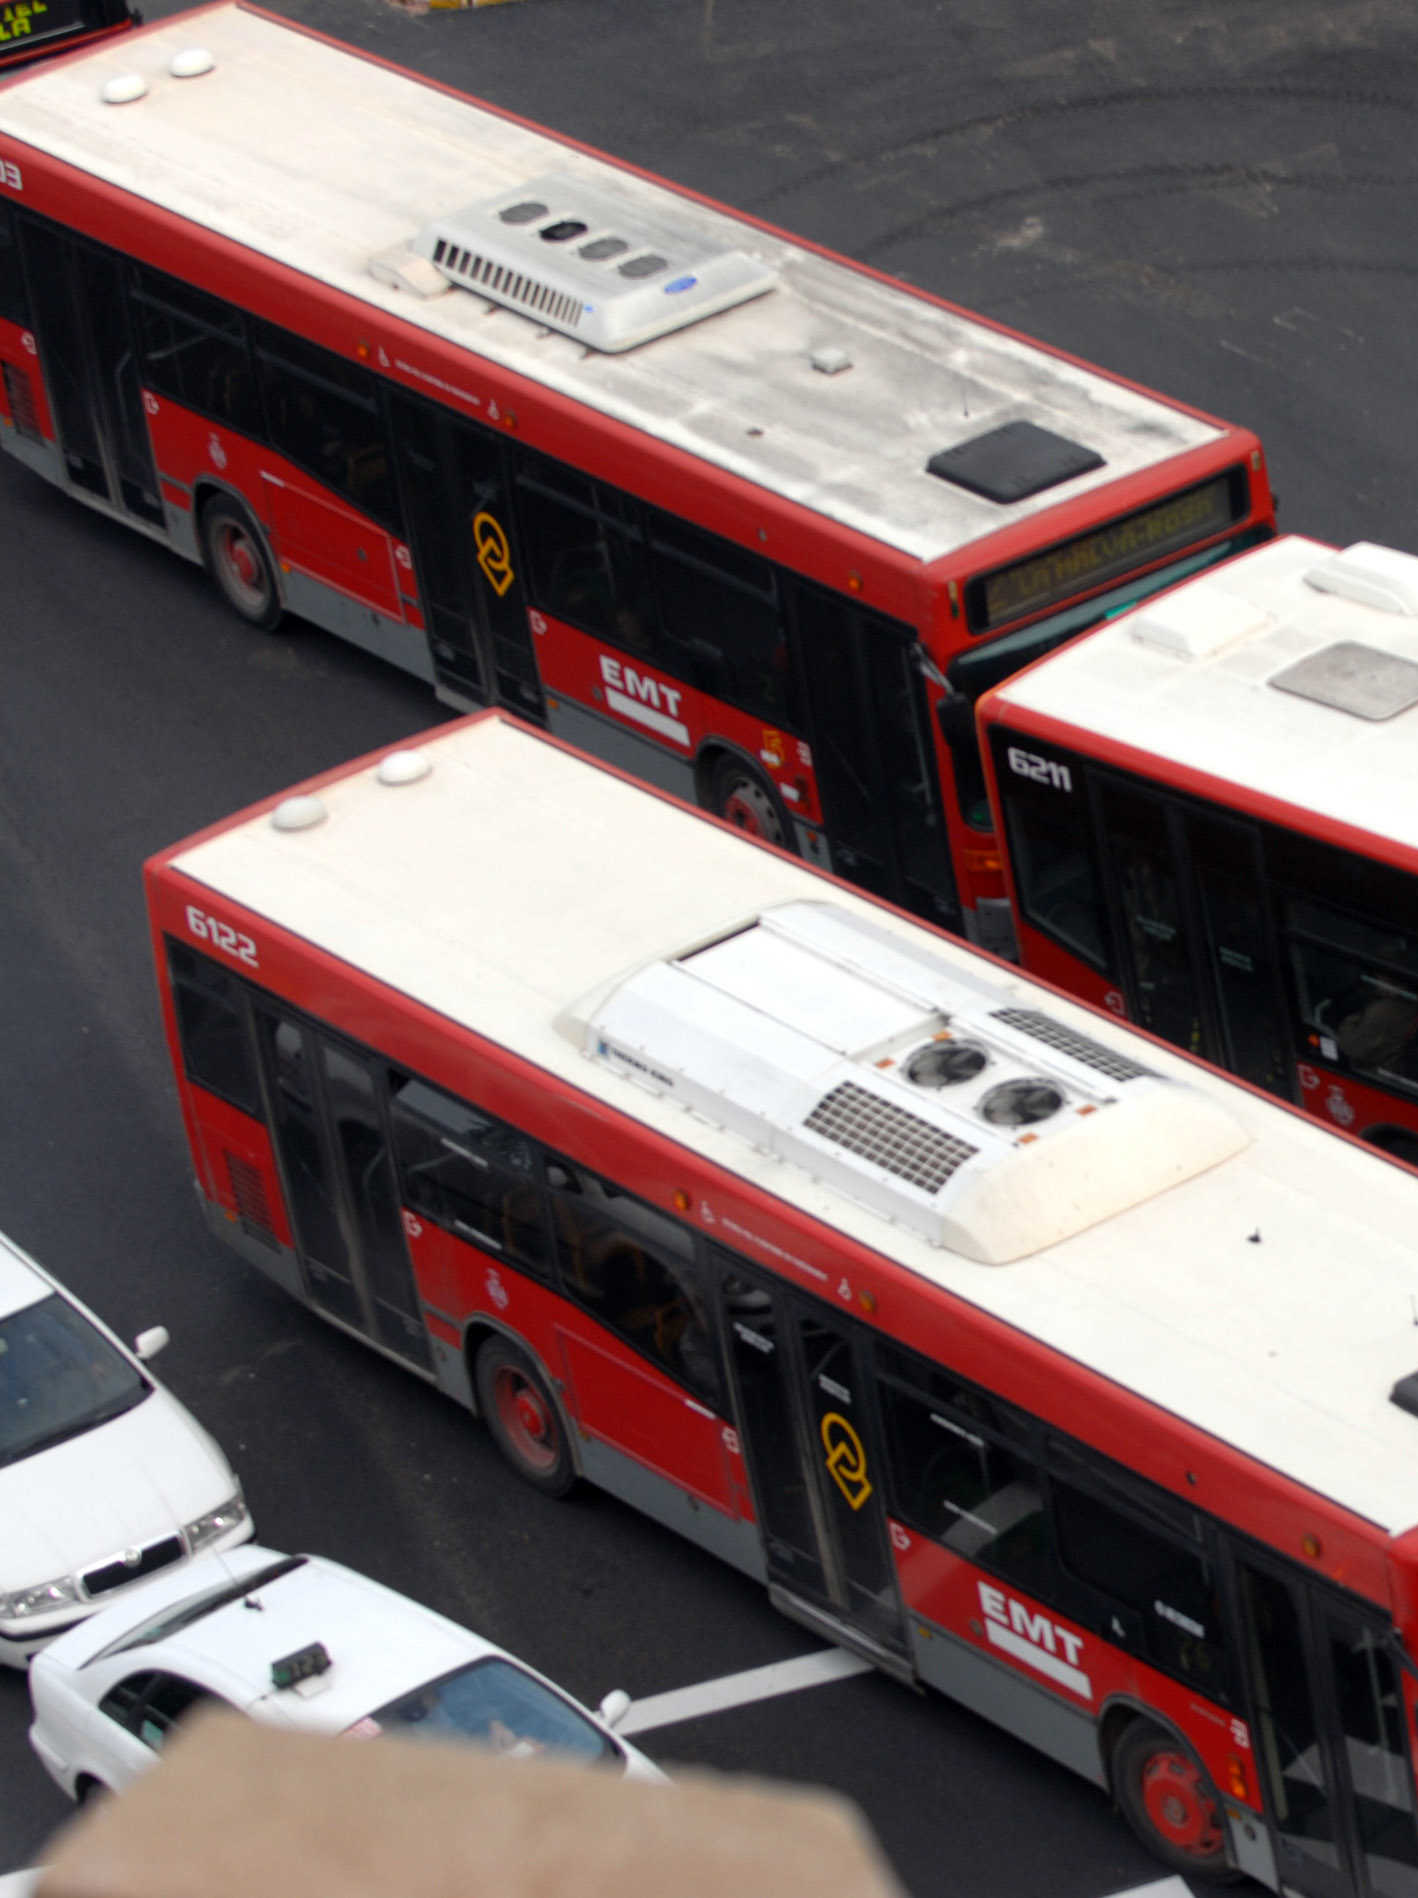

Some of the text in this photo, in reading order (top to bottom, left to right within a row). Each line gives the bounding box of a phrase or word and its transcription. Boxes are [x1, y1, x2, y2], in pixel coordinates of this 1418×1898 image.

[600, 653, 682, 717] EMT
[1007, 746, 1072, 793] 6211
[186, 904, 259, 968] 6122
[977, 1579, 1084, 1666] EMT
